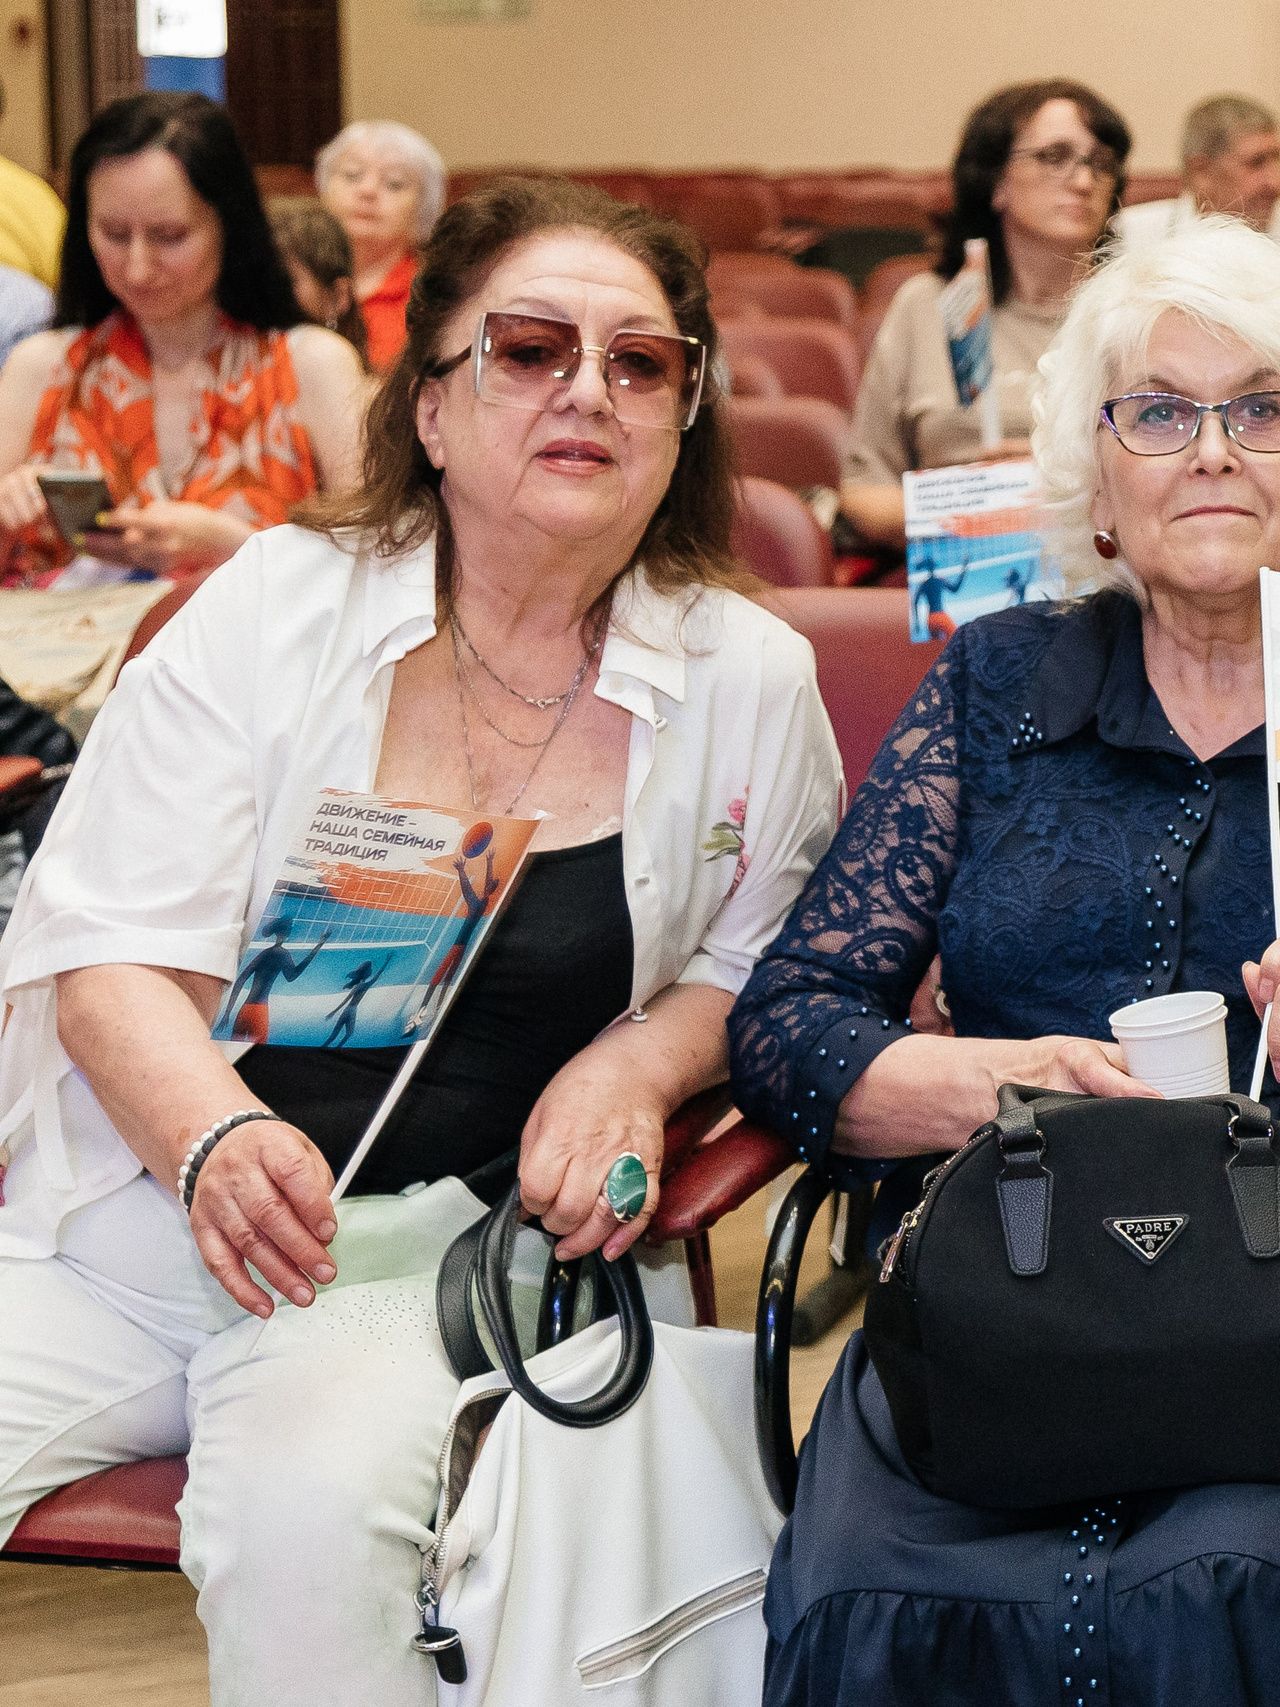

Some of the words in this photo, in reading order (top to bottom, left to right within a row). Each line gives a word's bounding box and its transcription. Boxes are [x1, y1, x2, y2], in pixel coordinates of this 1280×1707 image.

[316, 802, 408, 827] ДВИЖЕНИЕ
[309, 820, 358, 839] НАША
[362, 829, 446, 852] СЕМЕЙНАЯ
[304, 837, 388, 862] ТРАДИЦИЯ
[1126, 1222, 1172, 1234] PADRE
